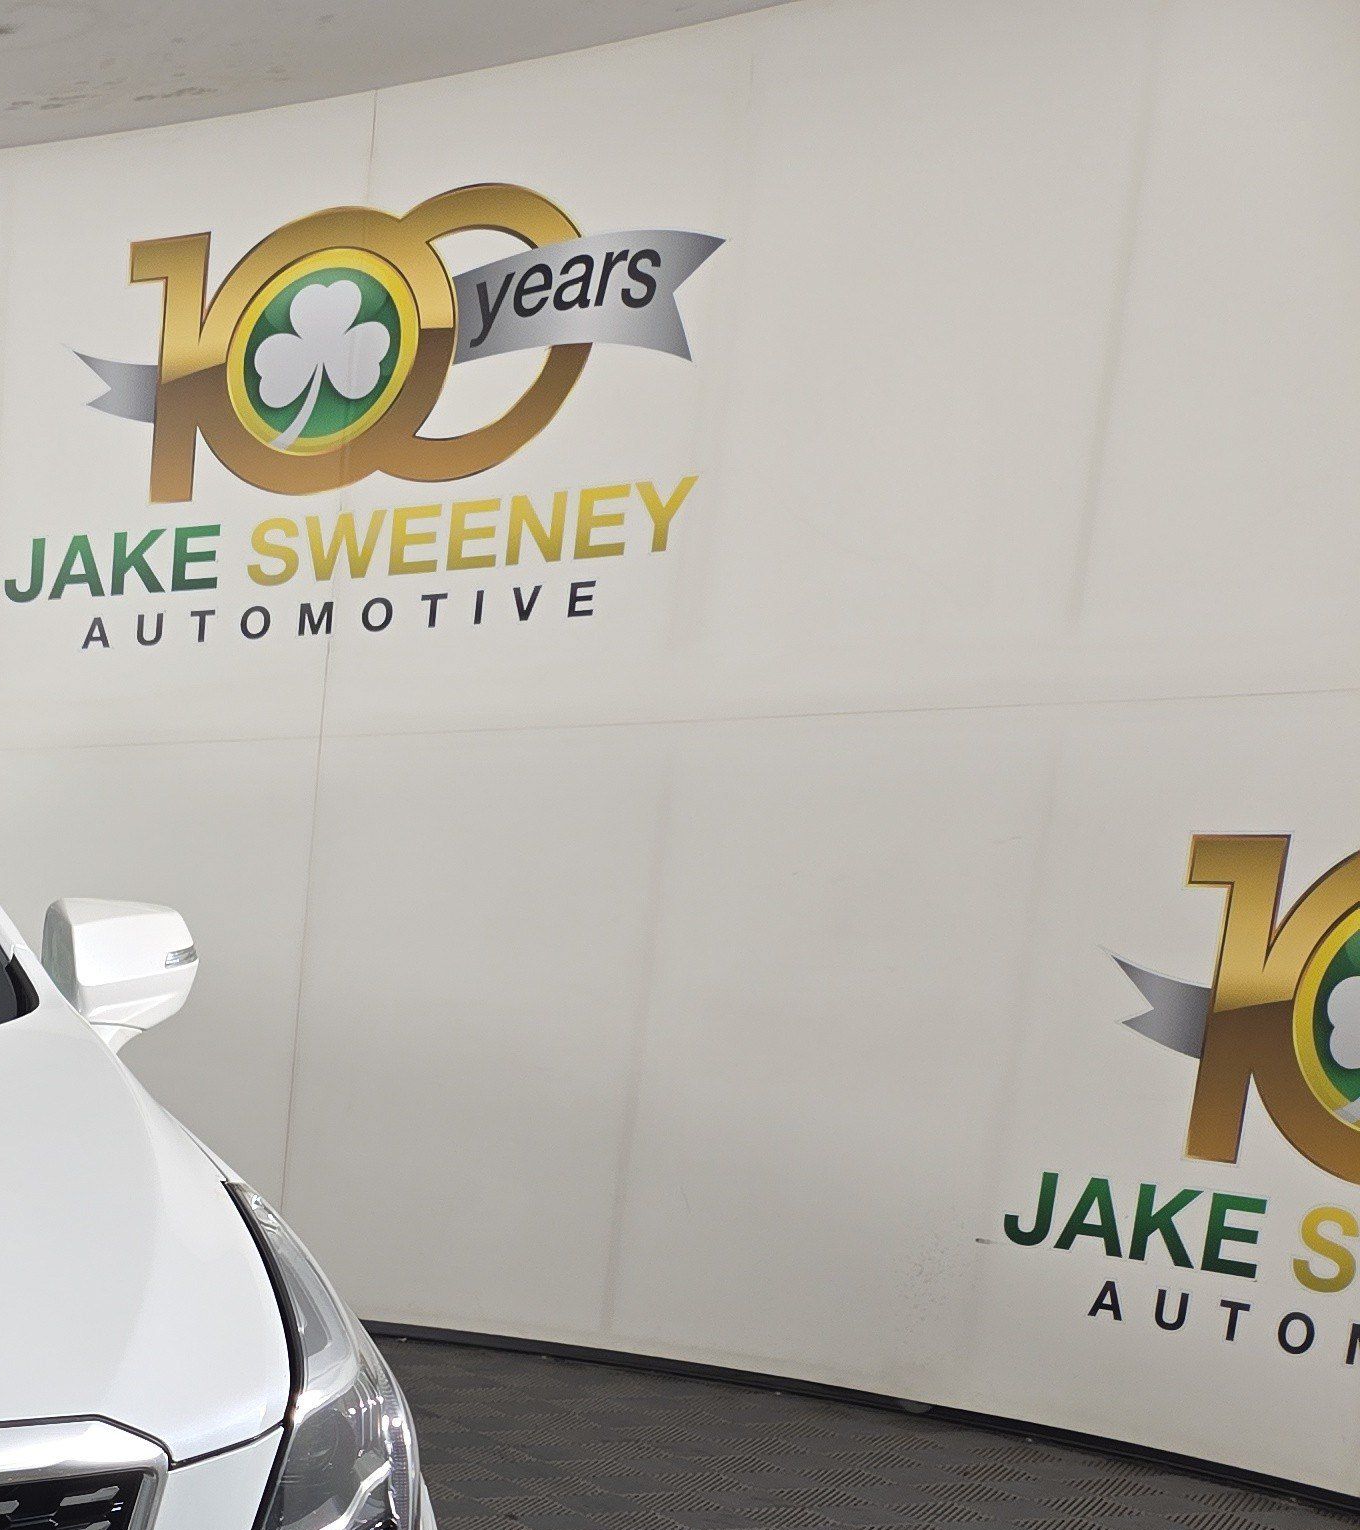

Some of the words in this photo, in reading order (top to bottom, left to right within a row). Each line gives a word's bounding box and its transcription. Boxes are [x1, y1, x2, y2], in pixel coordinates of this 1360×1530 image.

[129, 182, 594, 504] 100
[469, 246, 661, 348] years
[3, 523, 221, 604] JAKE
[247, 475, 699, 587] SWEENEY
[81, 580, 597, 650] AUTOMOTIVE
[1003, 1171, 1268, 1280] JAKE
[1292, 1206, 1360, 1293] S
